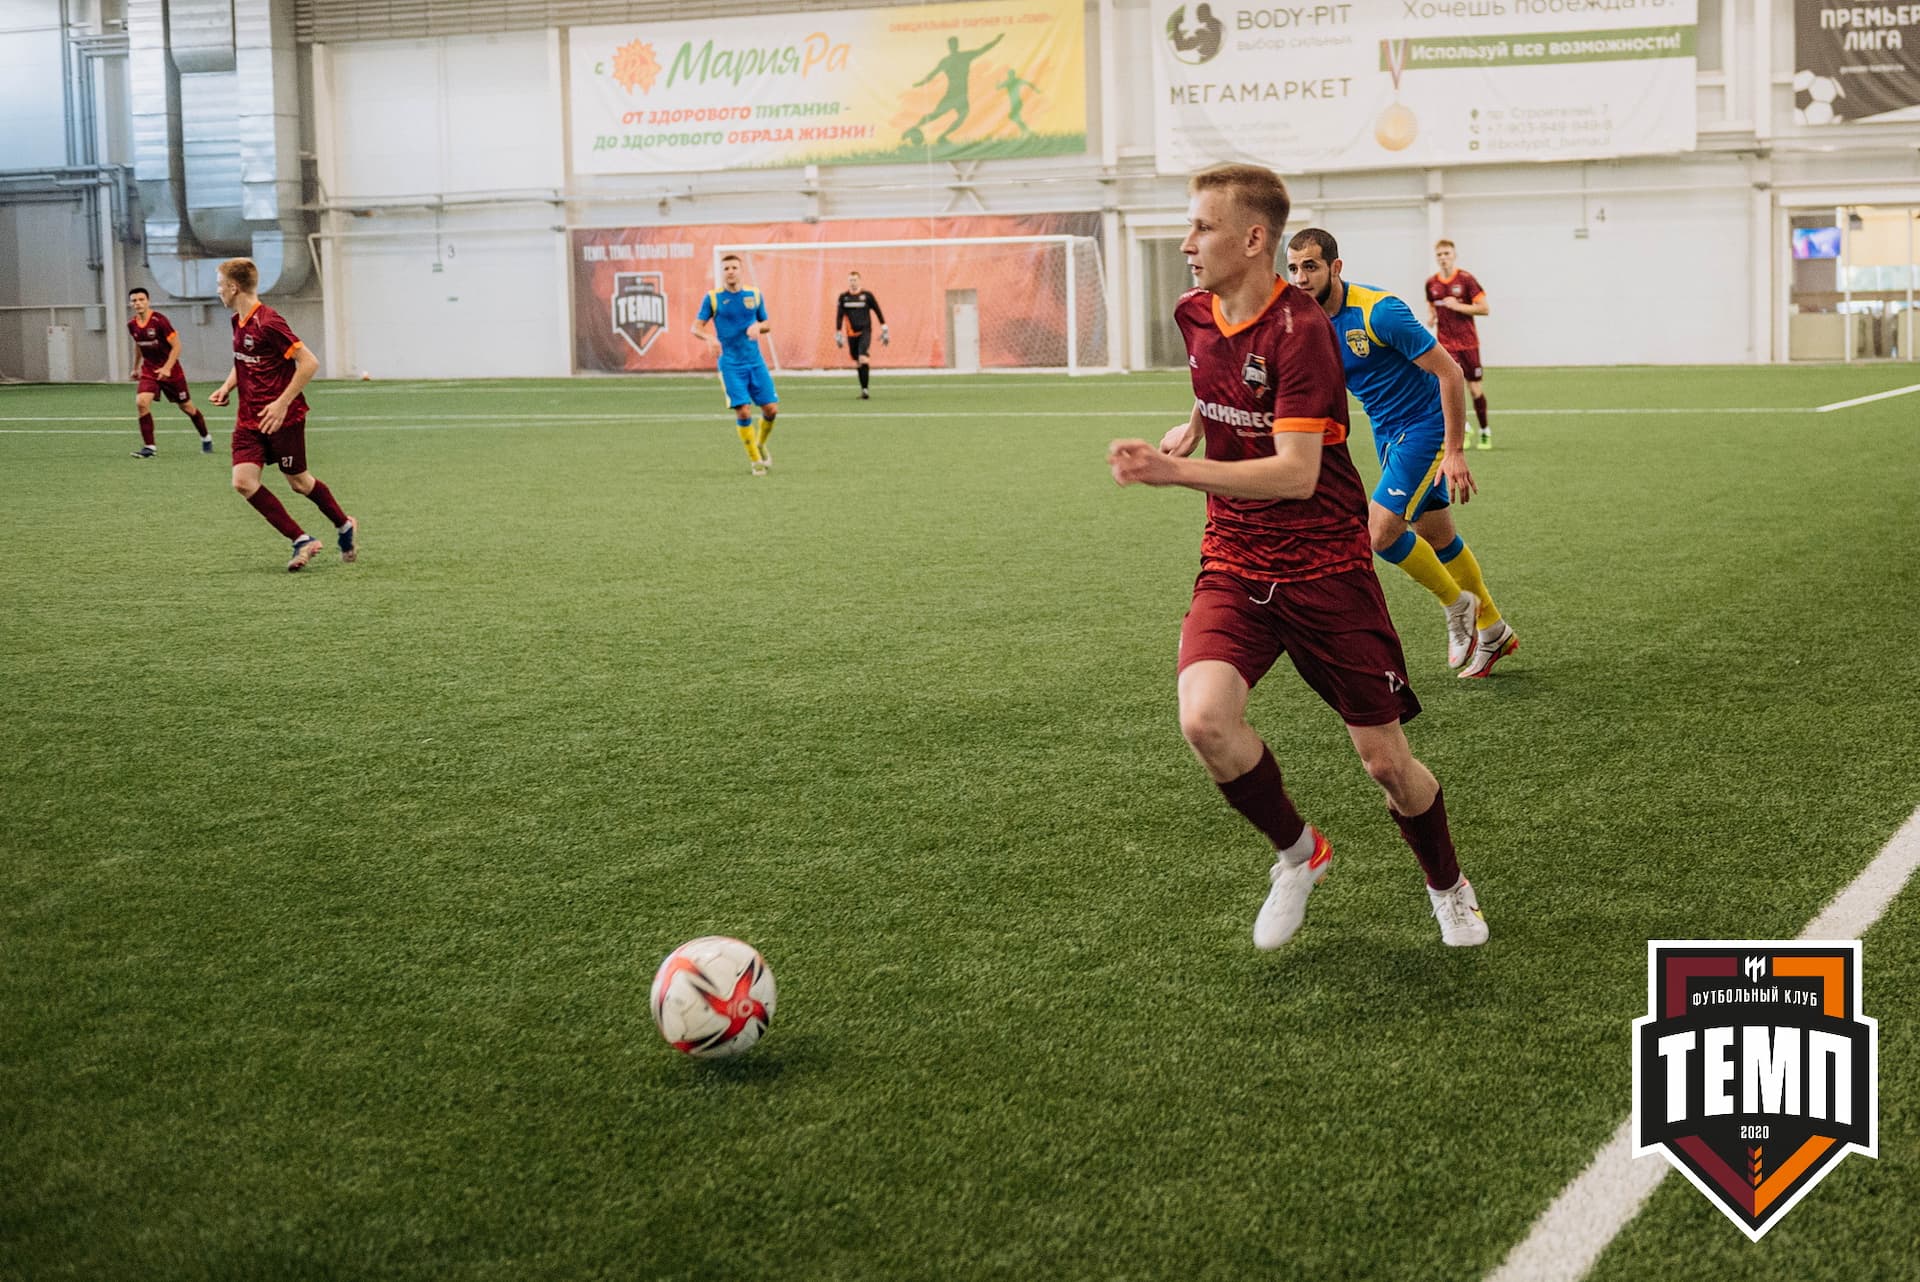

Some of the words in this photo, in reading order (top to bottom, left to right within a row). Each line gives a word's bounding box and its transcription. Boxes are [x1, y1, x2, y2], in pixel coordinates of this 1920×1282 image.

[1237, 4, 1352, 30] BODY-PIT
[1515, 0, 1676, 14] побежда
[1820, 4, 1920, 29] ПРЕМЬЕР
[1411, 42, 1509, 61] Используй
[1512, 42, 1545, 58] все
[1549, 32, 1681, 56] возможности!
[1843, 29, 1903, 51] ЛИГА
[1170, 77, 1352, 105] МЕГАМАРКЕТ
[621, 111, 645, 125] ОТ
[647, 105, 752, 124] ЗДОРОВОГО
[755, 101, 841, 119] ПИТАНИЯ
[593, 134, 618, 151] ДО
[621, 130, 724, 149] ЗДОРОВОГО
[727, 127, 794, 144] ОБРАЗА
[617, 295, 664, 325] ТЕМП
[282, 456, 294, 468] 27
